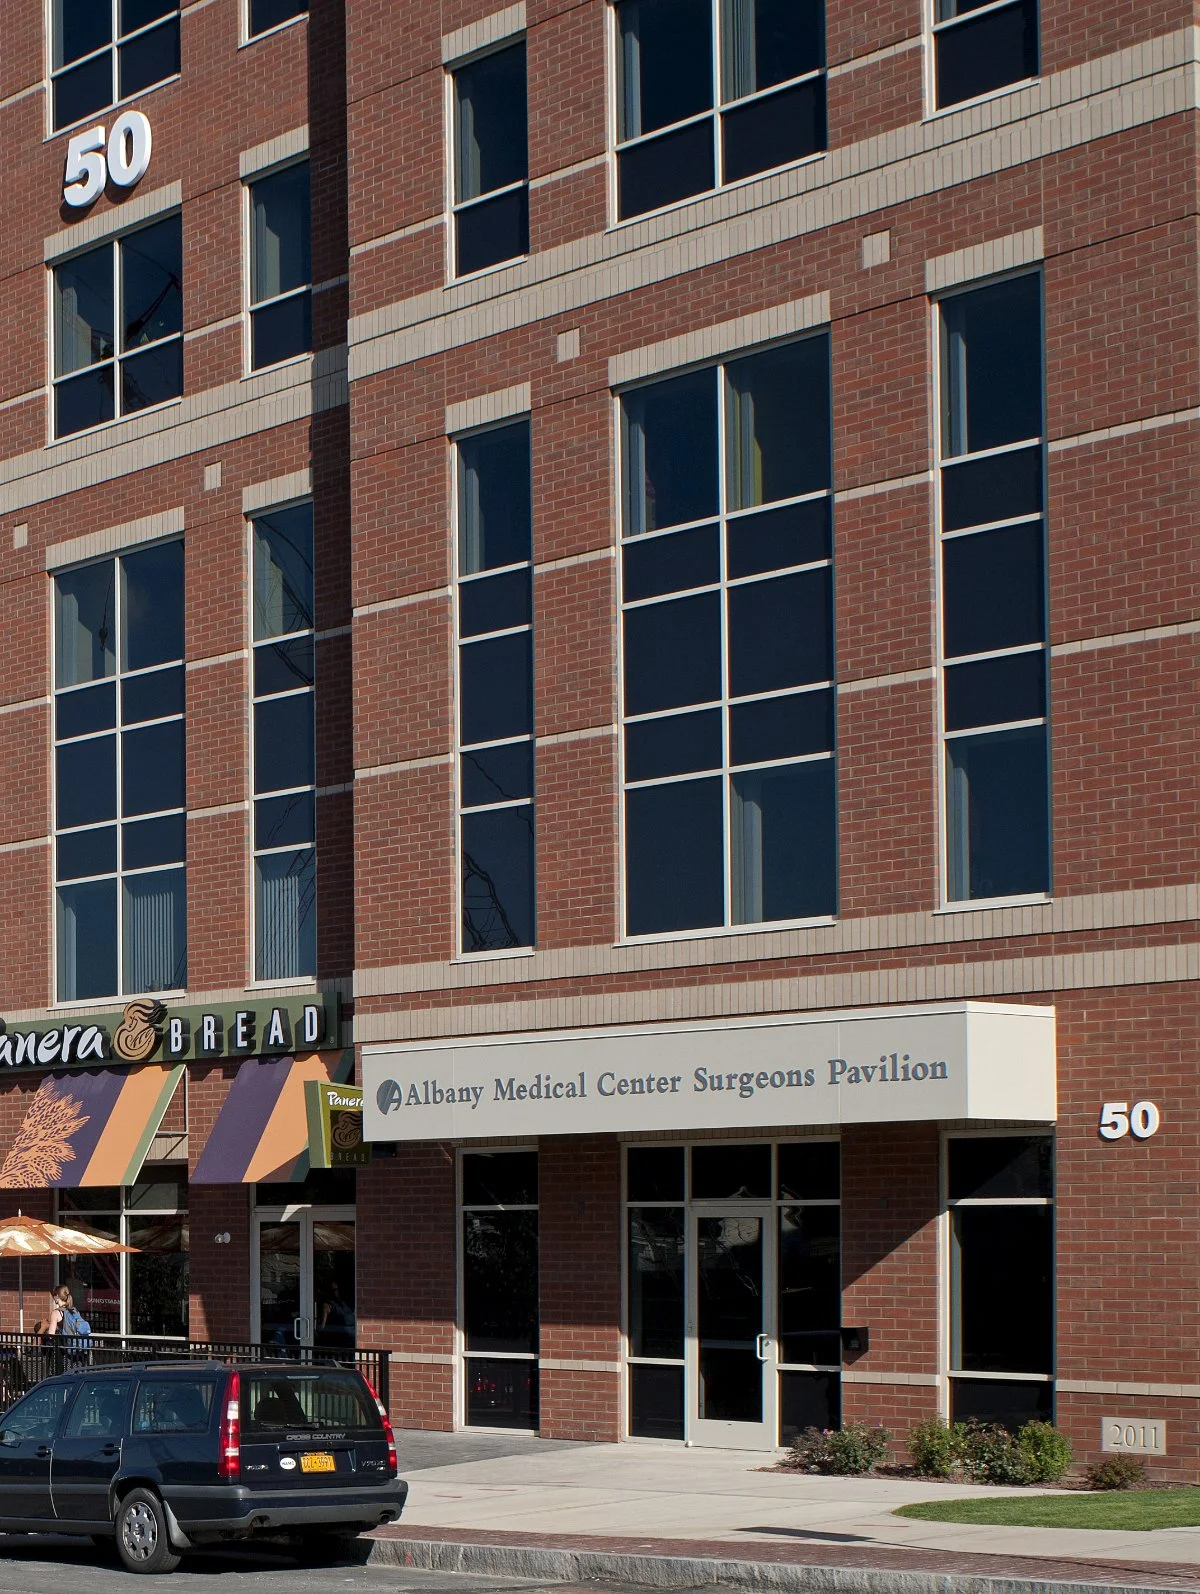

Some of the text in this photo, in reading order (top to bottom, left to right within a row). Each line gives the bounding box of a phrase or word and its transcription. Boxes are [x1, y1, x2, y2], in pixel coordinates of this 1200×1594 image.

[63, 110, 152, 207] 50
[170, 1005, 319, 1054] BREAD
[404, 1079, 484, 1110] Albany
[493, 1071, 587, 1101] Medical
[597, 1071, 682, 1097] Center
[693, 1066, 816, 1099] Surgeons
[827, 1052, 949, 1085] Pavilion
[1100, 1101, 1160, 1139] 50
[286, 1432, 346, 1441] CROSS COUNTRY
[1108, 1424, 1159, 1449] 2011
